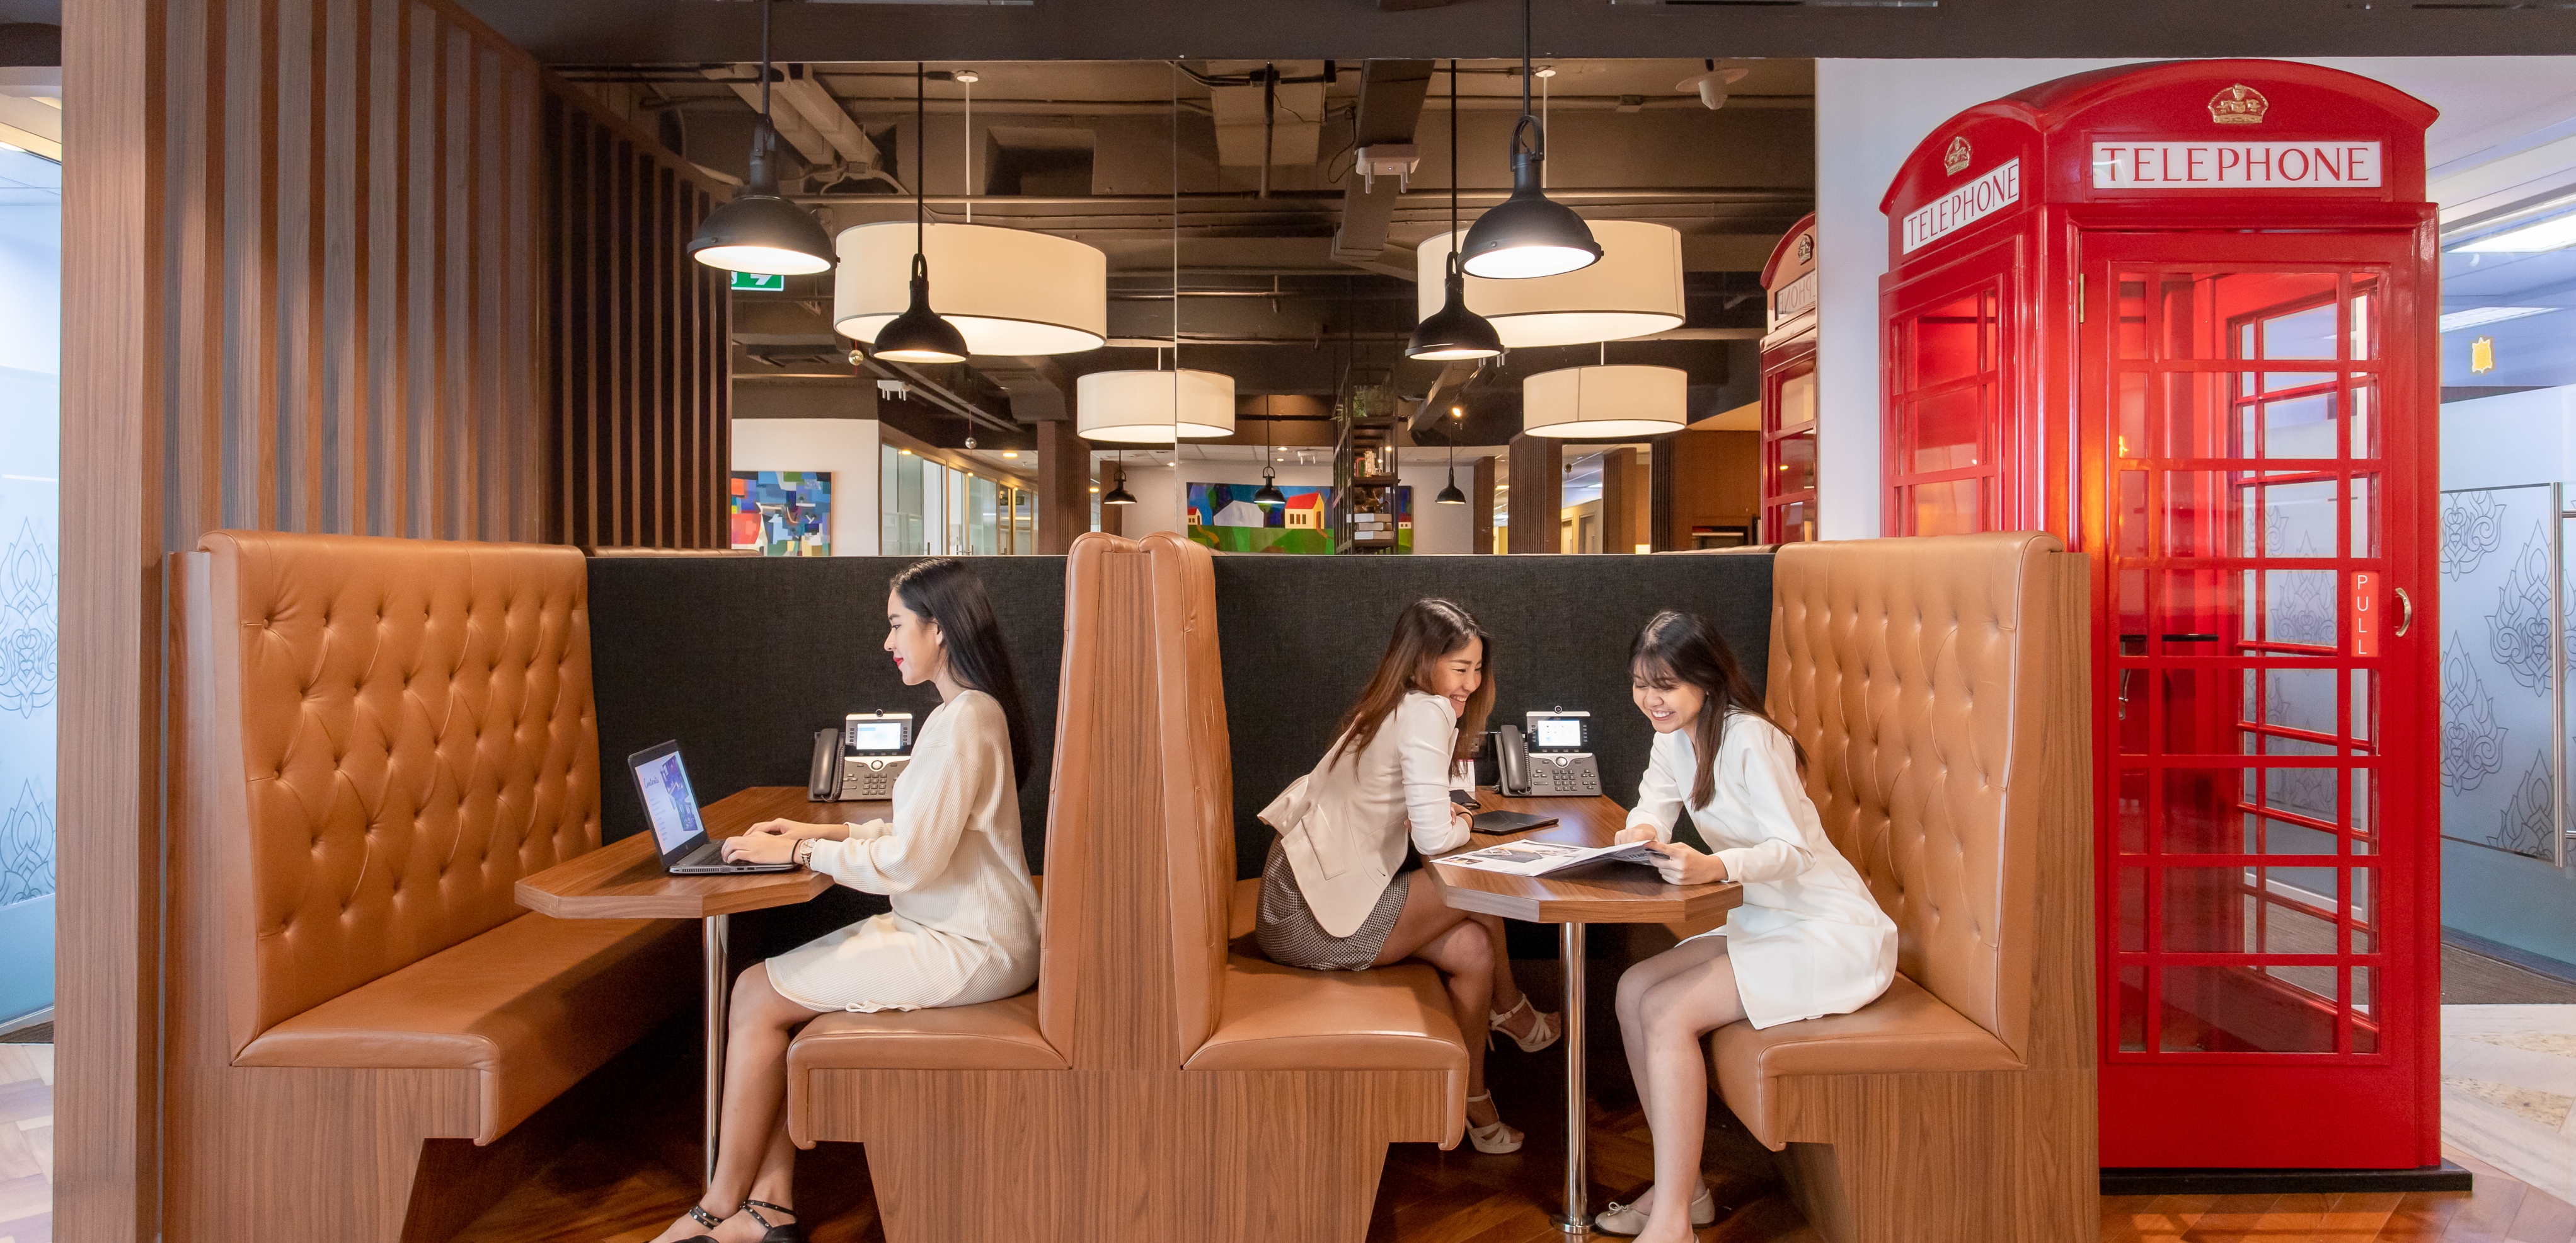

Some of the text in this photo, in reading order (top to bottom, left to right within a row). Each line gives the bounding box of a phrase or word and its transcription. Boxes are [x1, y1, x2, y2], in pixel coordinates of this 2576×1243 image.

[2100, 147, 2369, 182] TELEPHONE
[1907, 163, 2018, 246] TELEPHONE
[2357, 574, 2369, 654] PULL
[643, 776, 659, 789] Contents
